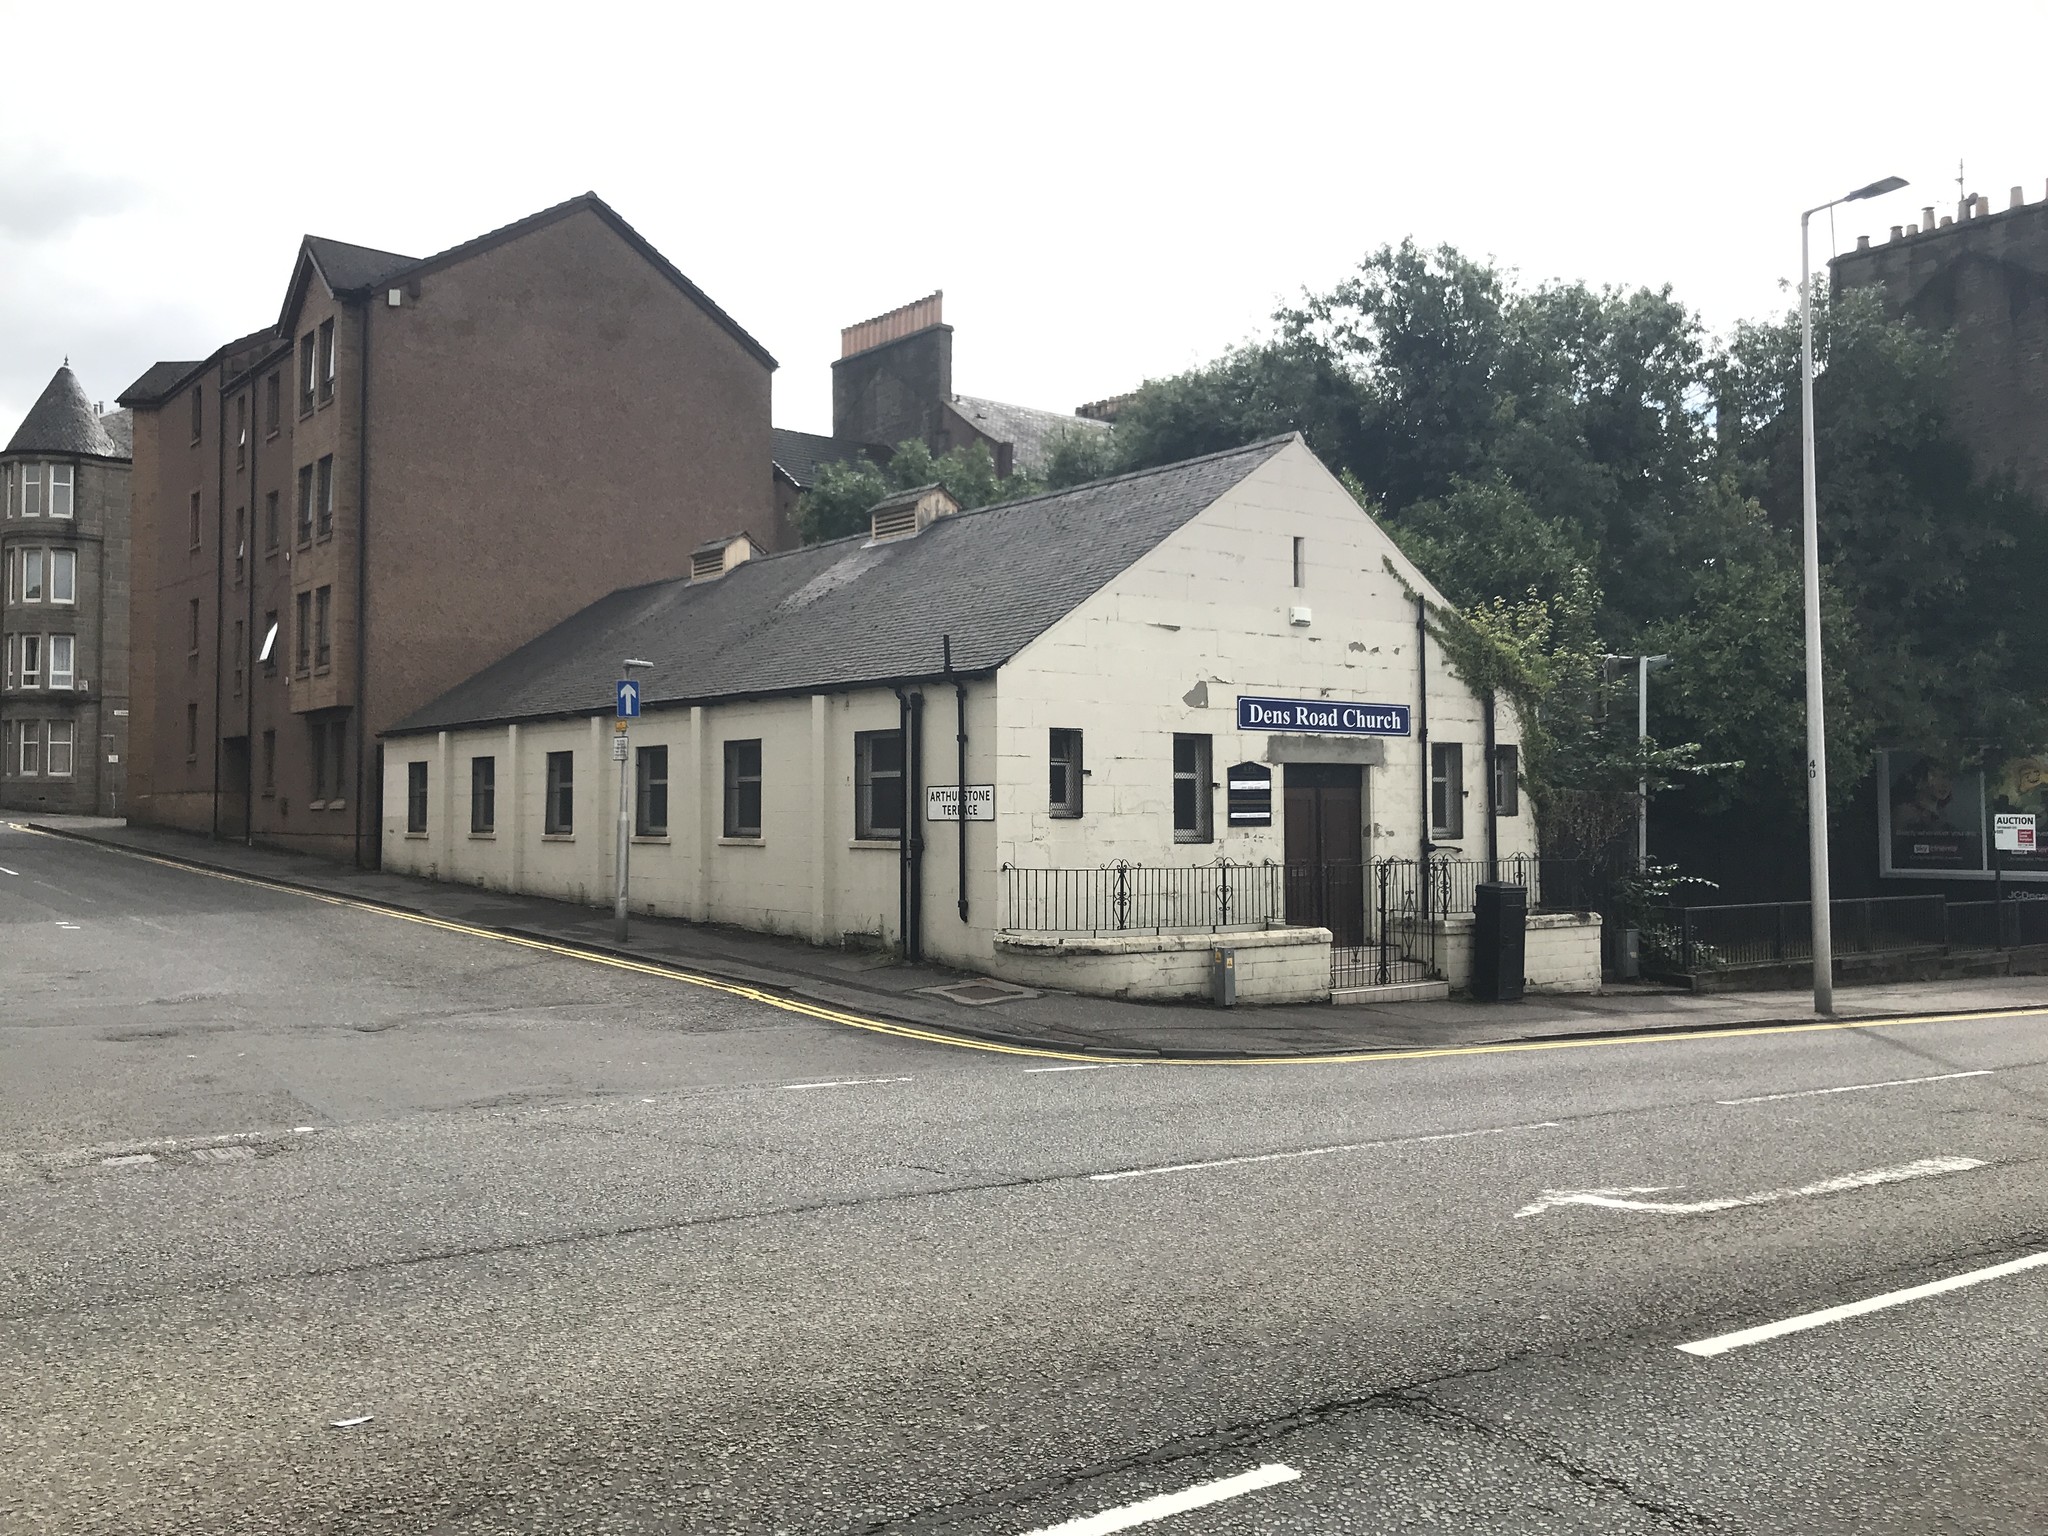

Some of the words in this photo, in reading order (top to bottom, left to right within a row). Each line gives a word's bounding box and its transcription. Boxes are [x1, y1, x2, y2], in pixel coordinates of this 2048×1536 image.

[1249, 704, 1290, 725] Dens
[1295, 707, 1338, 727] Road
[1342, 708, 1401, 730] Church
[930, 790, 990, 802] ARTHUSTONE
[942, 804, 978, 816] TERACE
[1996, 816, 2034, 825] AUCTION
[2007, 890, 2048, 900] JCDeca
